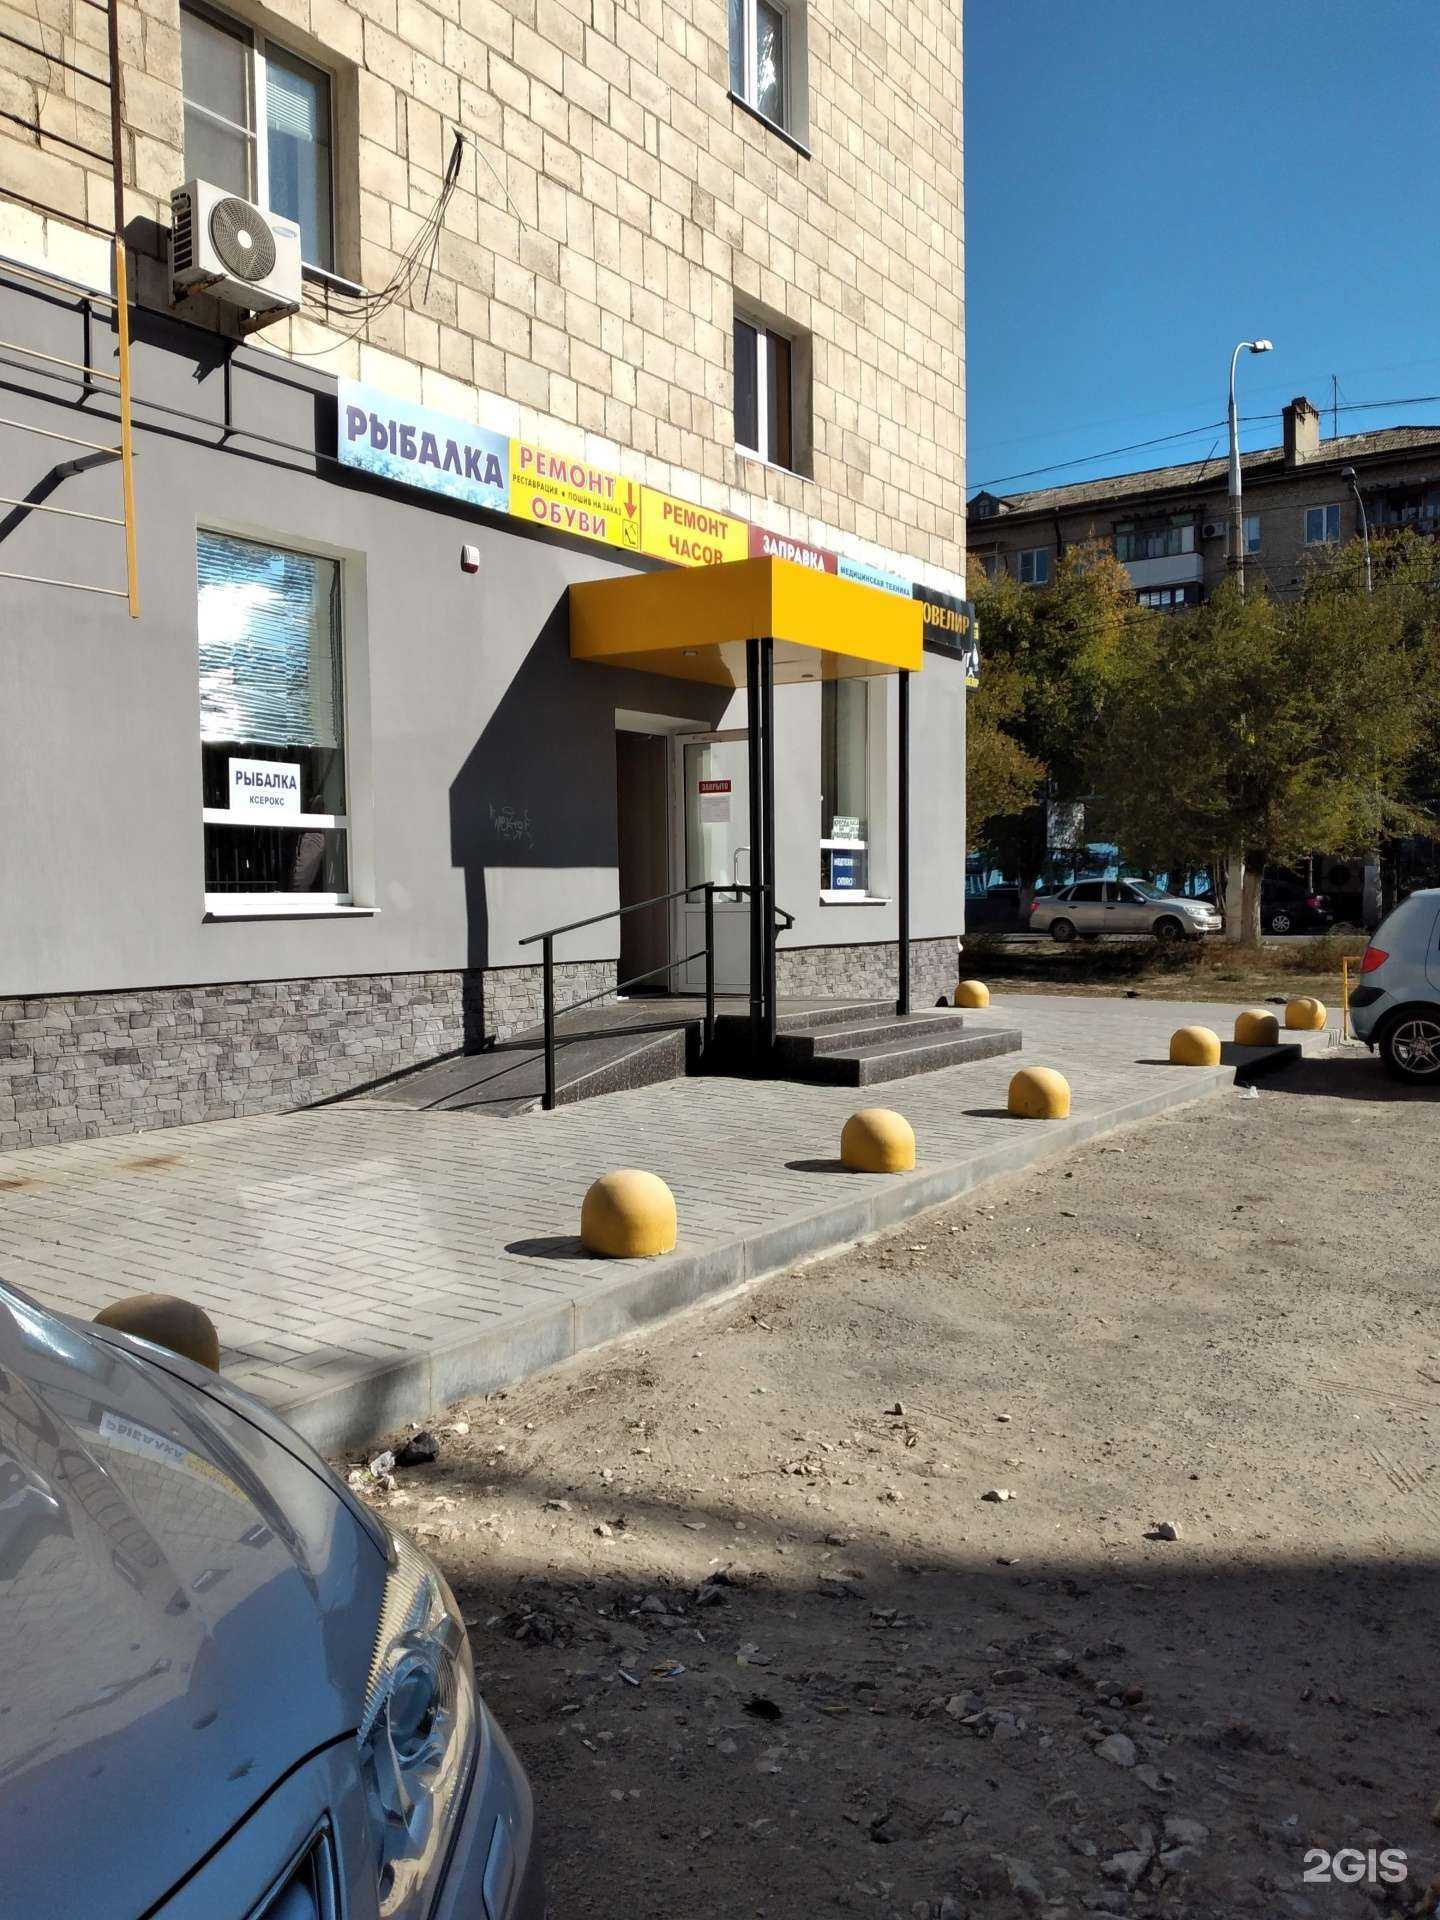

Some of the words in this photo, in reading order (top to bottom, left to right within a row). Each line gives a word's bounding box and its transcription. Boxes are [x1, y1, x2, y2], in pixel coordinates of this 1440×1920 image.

[345, 404, 504, 489] РЫБАЛКА
[519, 446, 615, 499] РЕМОНТ
[512, 473, 558, 495] РЕСТАВРАЦИЯ
[567, 491, 592, 507] ПОШИВ
[593, 500, 602, 510] НА
[532, 496, 606, 537] ОБУВИ
[663, 501, 729, 540] РЕМОНТ
[669, 534, 723, 566] ЧАСОВ
[762, 534, 825, 572] ЗАПРАВКА
[840, 565, 885, 588] МЕДИЦИНСКАЯ
[885, 581, 911, 597] ТЕХНИКА
[235, 770, 298, 790] РЫБАЛКА
[249, 795, 286, 807] КСЕРОКС
